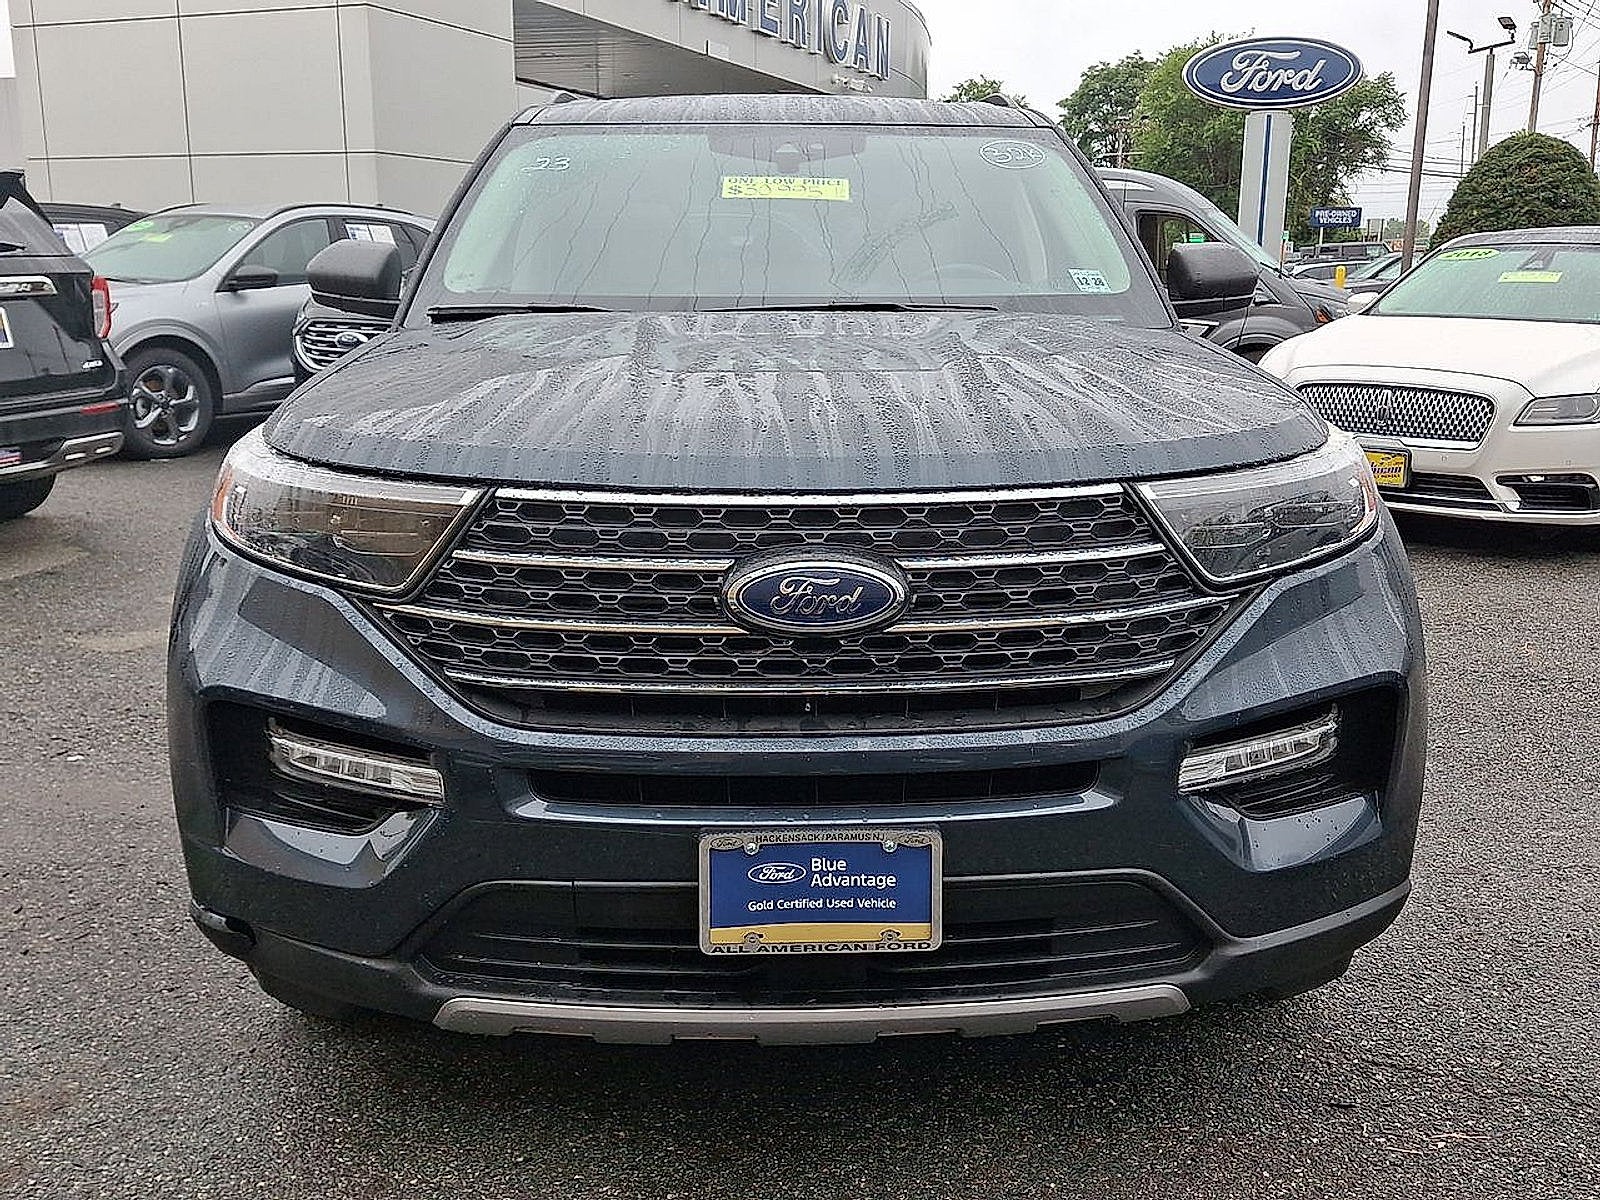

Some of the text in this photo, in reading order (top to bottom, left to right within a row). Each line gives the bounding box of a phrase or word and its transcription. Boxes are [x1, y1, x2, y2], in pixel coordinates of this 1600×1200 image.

[680, 0, 890, 80] ERICAN
[1219, 50, 1327, 93] Ford
[764, 177, 797, 186] LOW
[770, 576, 864, 614] Ford
[810, 858, 847, 872] Blue
[758, 866, 796, 881] Ford
[810, 873, 897, 889] Advantage
[748, 897, 897, 911] Gold Certified Used Vehicle
[711, 941, 931, 954] ALL AMERICAN FORD
